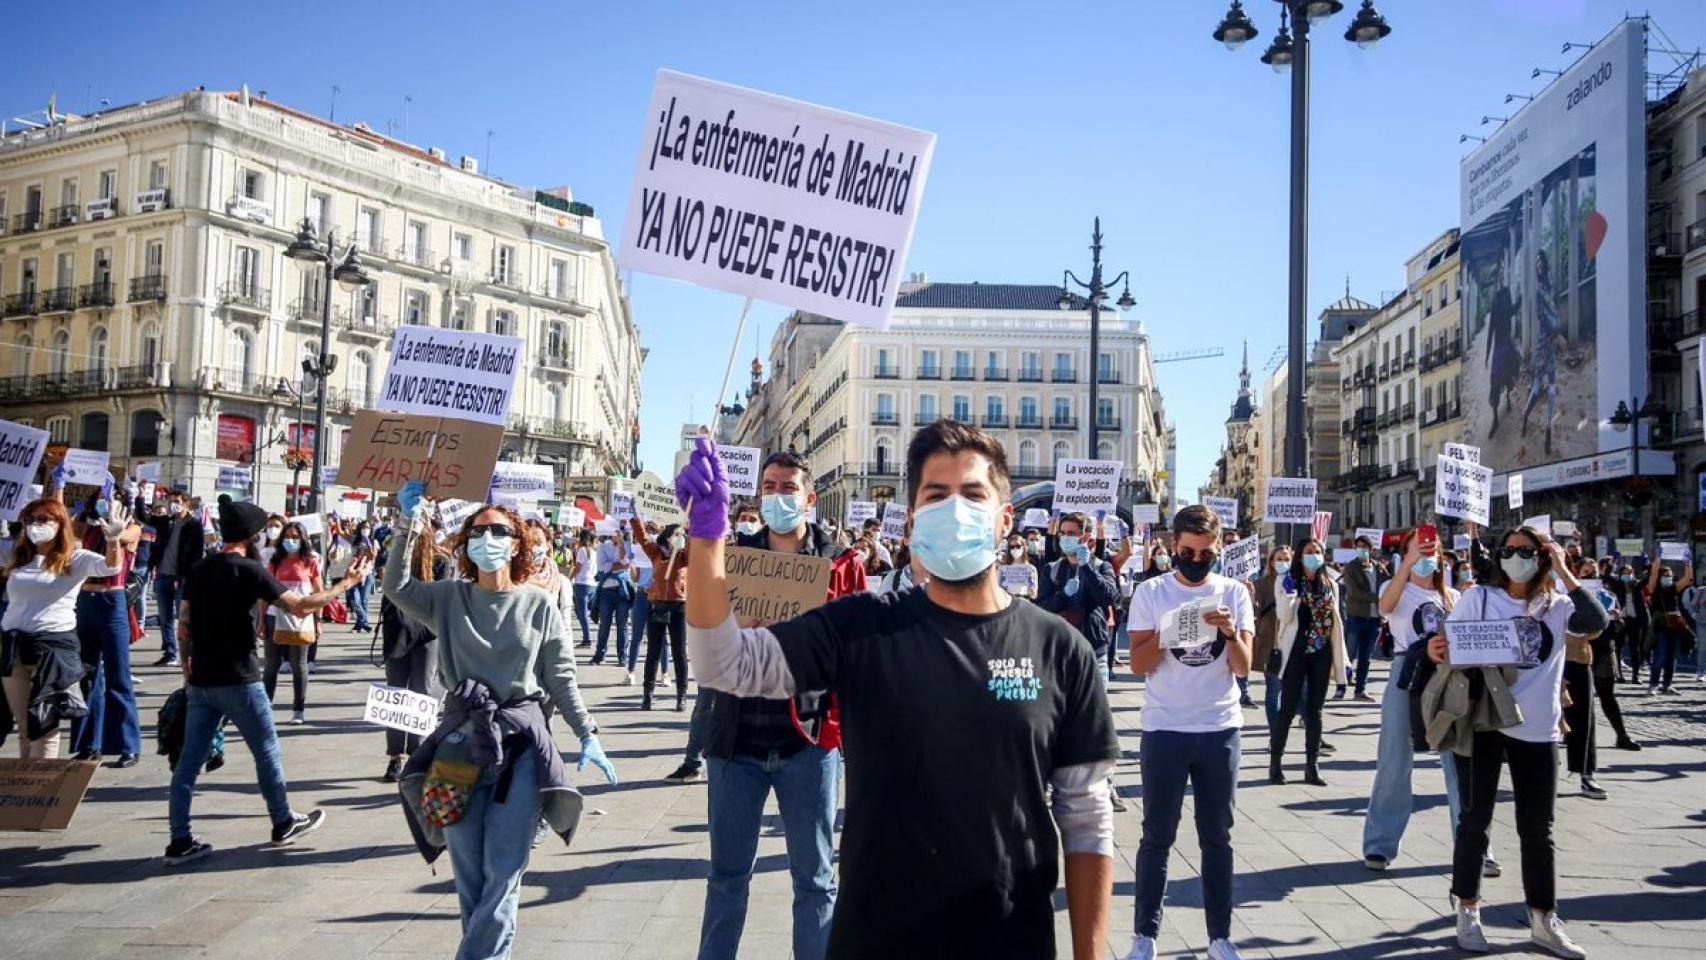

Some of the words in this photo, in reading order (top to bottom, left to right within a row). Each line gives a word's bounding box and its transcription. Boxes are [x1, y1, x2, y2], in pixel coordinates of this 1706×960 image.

[1567, 61, 1612, 111] zalando
[650, 97, 690, 170] ¡La
[692, 109, 806, 189] enfermería
[806, 133, 834, 197] de
[835, 139, 917, 216] Madrid
[637, 187, 667, 253] YA
[665, 195, 705, 261] NO
[702, 205, 786, 280] PUEDE
[780, 224, 895, 308] RESISTIR!
[393, 333, 413, 366] ¡La
[414, 336, 466, 367] enfermería
[465, 342, 479, 369] de
[479, 344, 517, 375] Madrid
[386, 373, 401, 401] YA
[400, 375, 418, 403] NO
[416, 376, 455, 408] PUEDE
[452, 382, 507, 416] RESISTIR!
[370, 418, 461, 450] ESTAMOS
[719, 450, 753, 461] ocación
[356, 454, 464, 487] HARTAS
[1065, 464, 1076, 474] La
[1079, 465, 1114, 476] vocación
[1566, 464, 1592, 478] TURISMO
[1065, 480, 1077, 489] no
[1077, 479, 1109, 491] justifica
[1056, 493, 1064, 503] la
[728, 586, 801, 620] FAMILIAR
[987, 657, 1016, 671] SOLO
[1021, 656, 1035, 668] EL
[992, 667, 1033, 681] PUEBLO
[987, 677, 1023, 691] SALVA
[1028, 677, 1043, 690] AL
[996, 688, 1038, 701] PUEBLO
[418, 699, 436, 715] LO
[370, 706, 431, 731] ¡PEDIMOS
